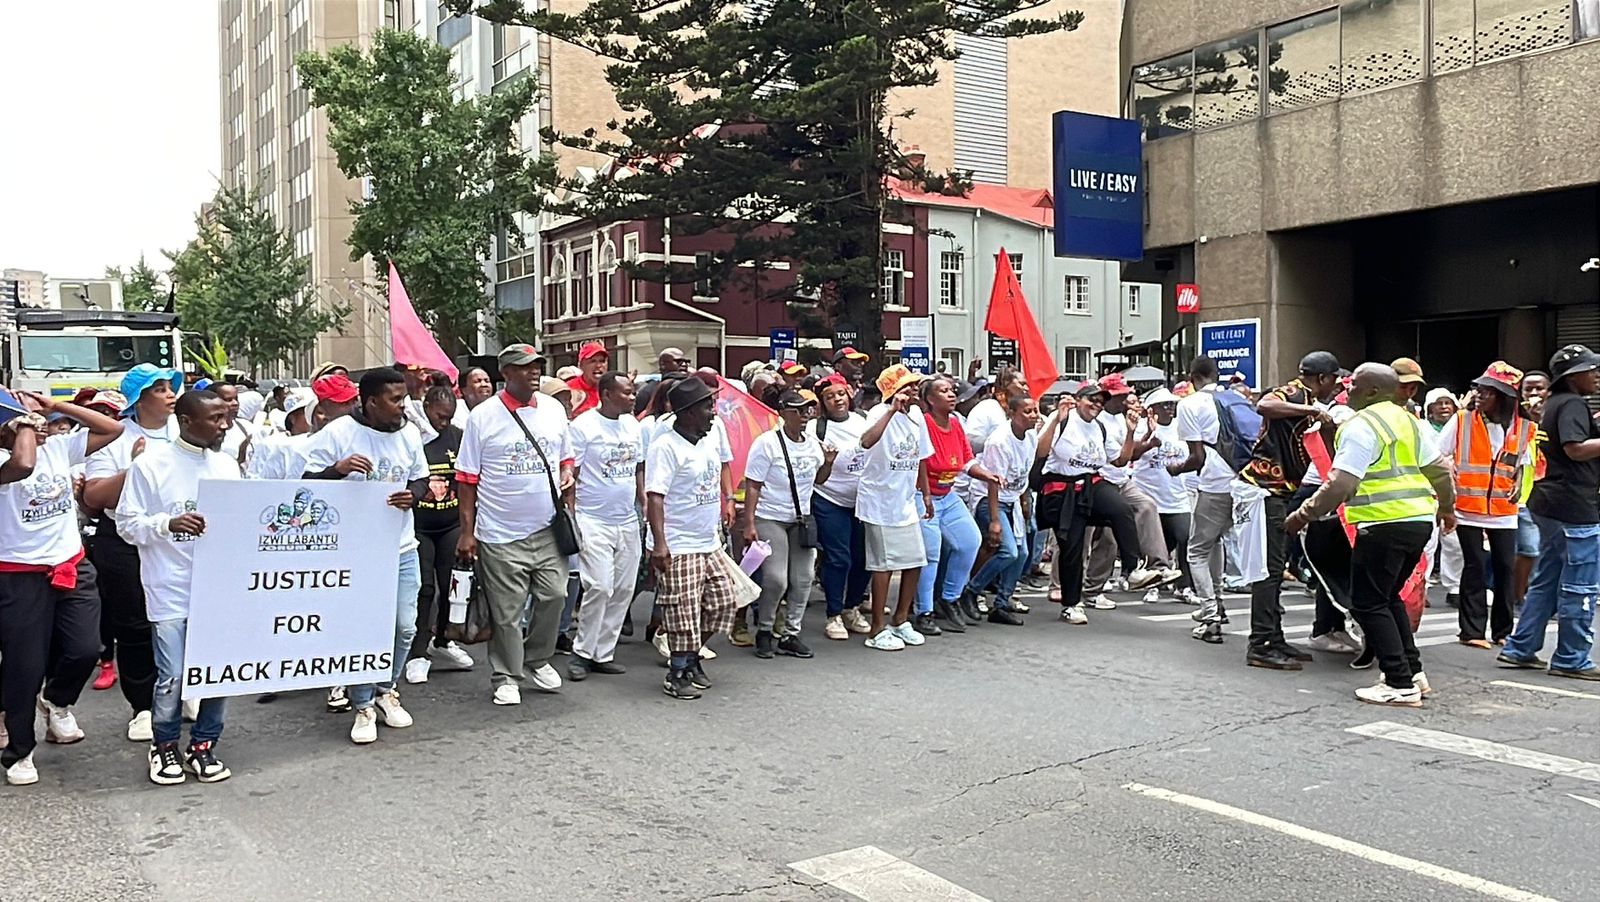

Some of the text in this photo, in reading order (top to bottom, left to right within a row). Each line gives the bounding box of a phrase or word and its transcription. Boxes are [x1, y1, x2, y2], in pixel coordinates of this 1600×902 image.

[1178, 288, 1199, 310] illy
[1207, 347, 1250, 359] ENTRANCE
[1218, 359, 1239, 369] ONLY
[259, 534, 338, 545] IZWI LABANTU
[248, 569, 351, 591] JUSTICE
[273, 614, 321, 634] FOR
[187, 653, 392, 686] BLACK FARMERS
